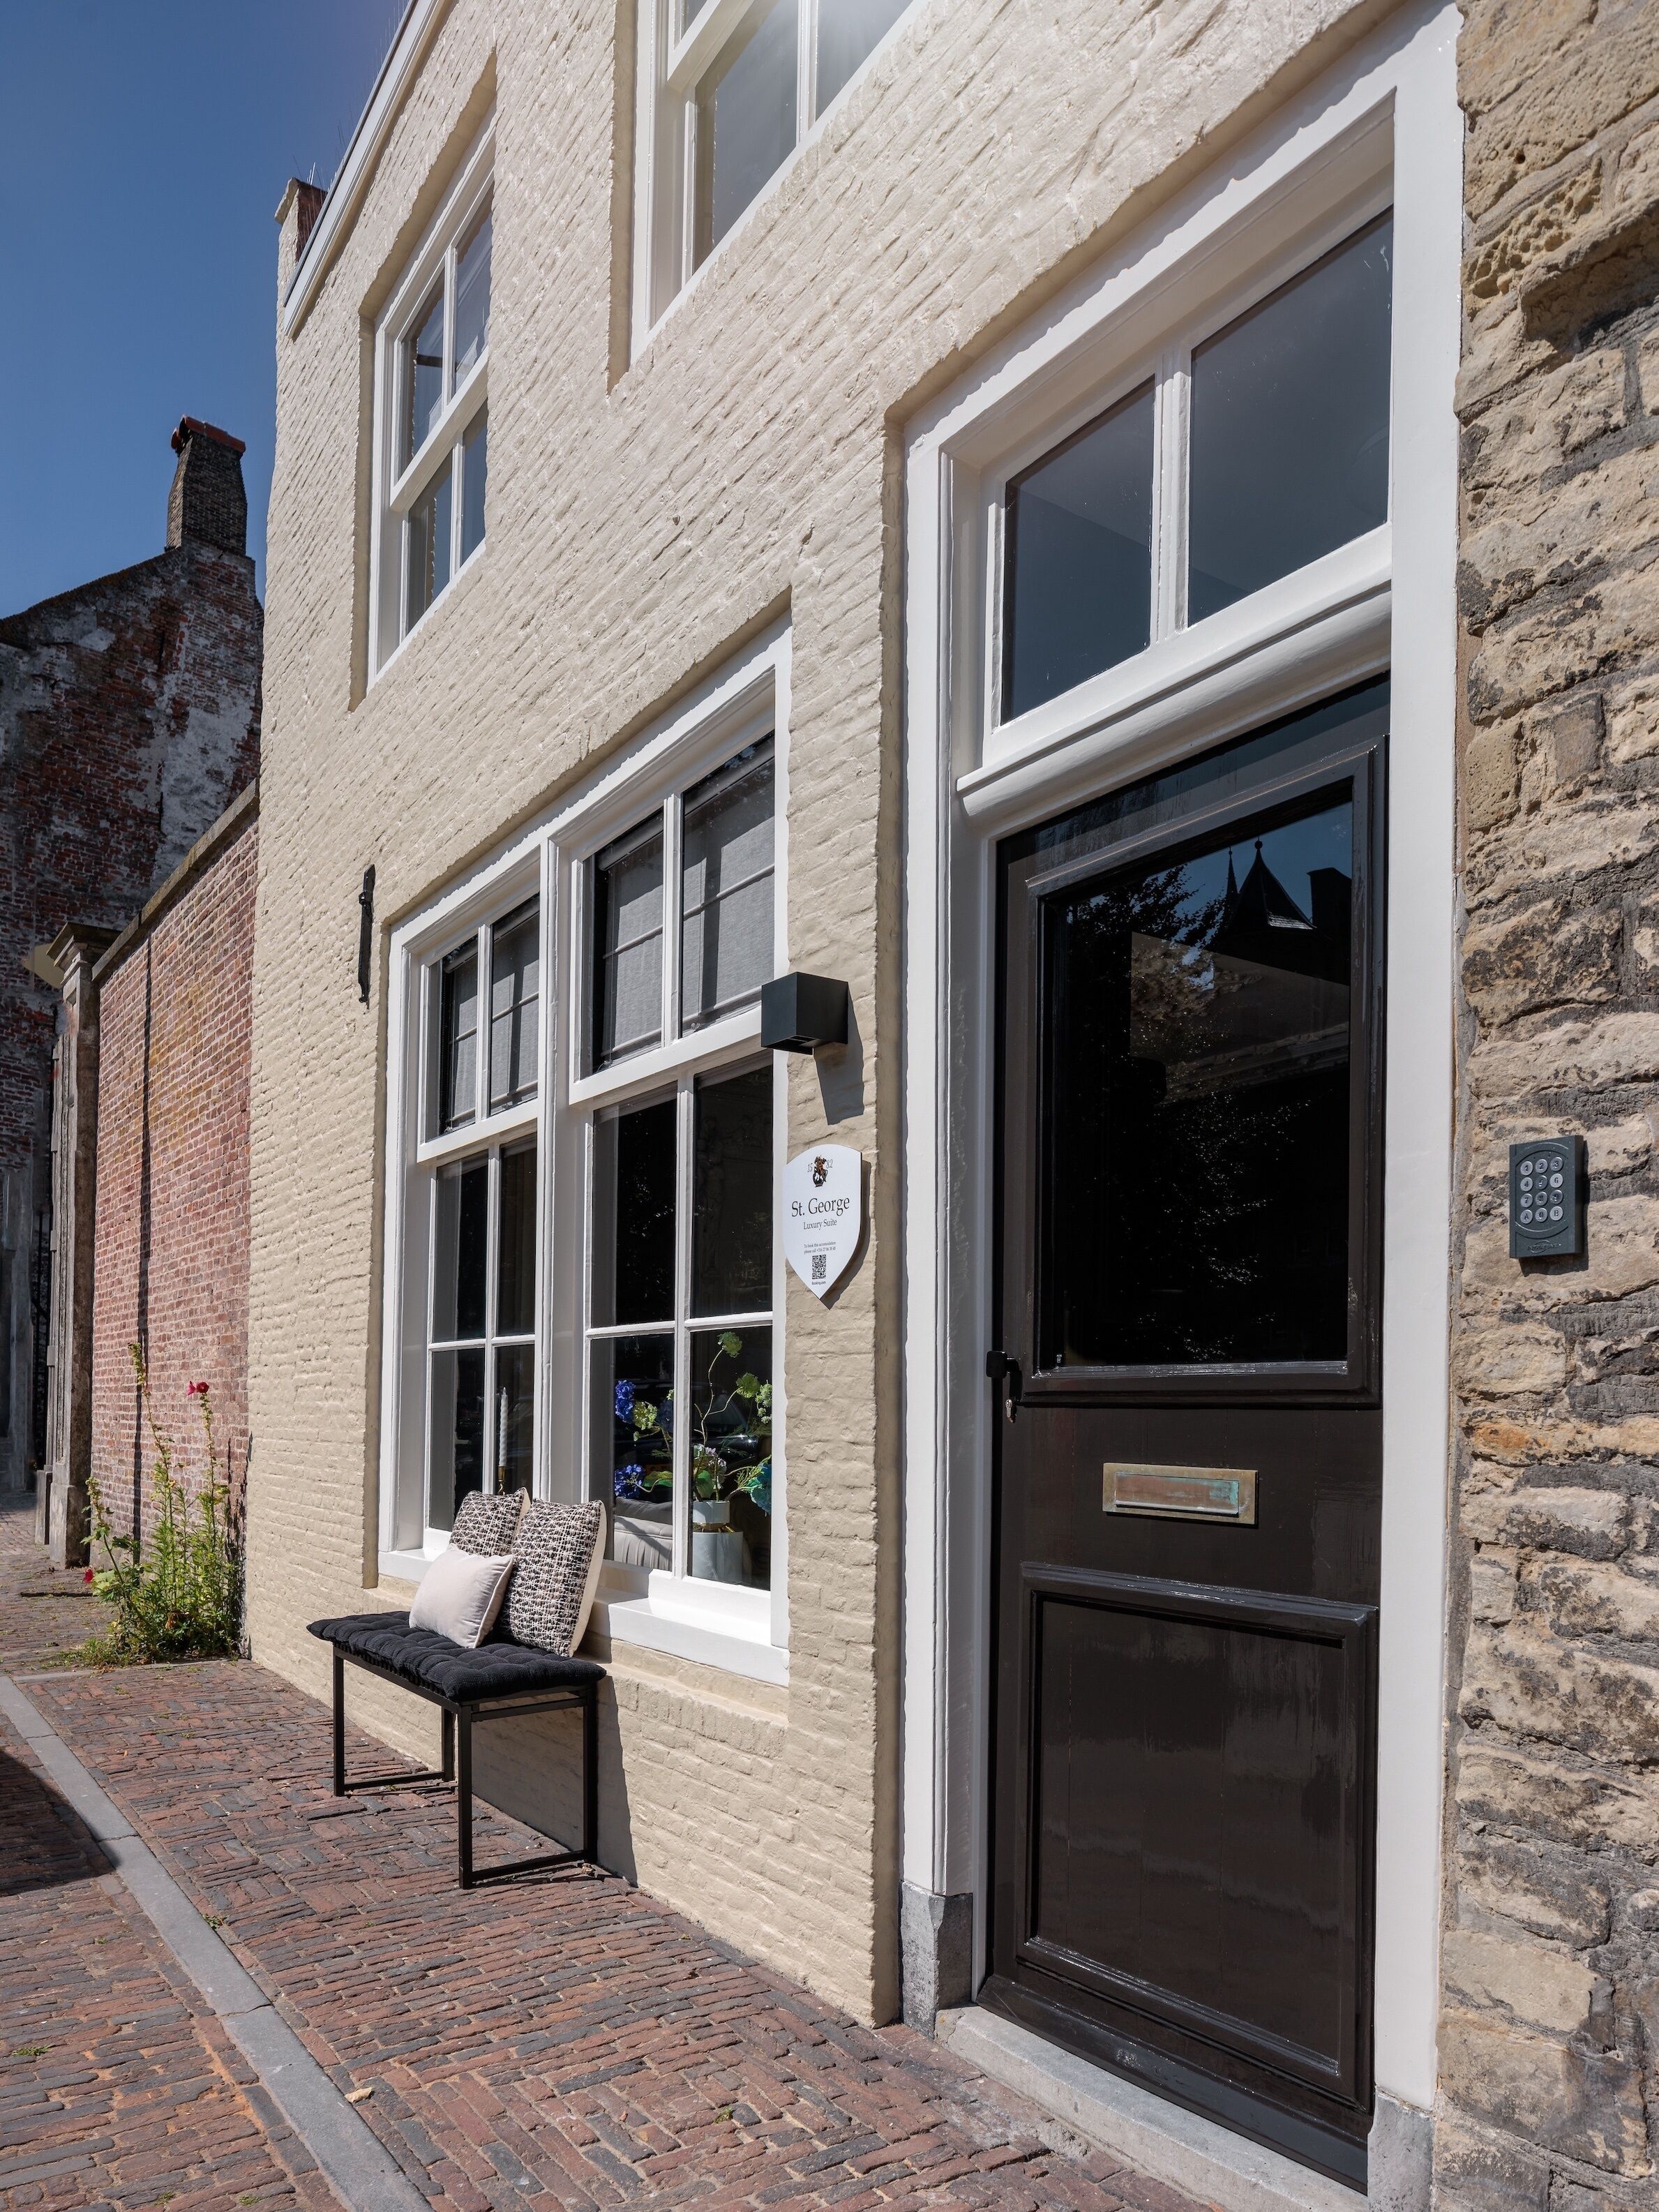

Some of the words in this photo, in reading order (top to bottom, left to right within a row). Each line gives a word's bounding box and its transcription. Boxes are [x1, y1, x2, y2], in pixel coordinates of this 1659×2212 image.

[791, 1200, 805, 1217] St.
[808, 1197, 850, 1216] George
[803, 1221, 823, 1230] Luxury
[823, 1218, 837, 1227] Suite
